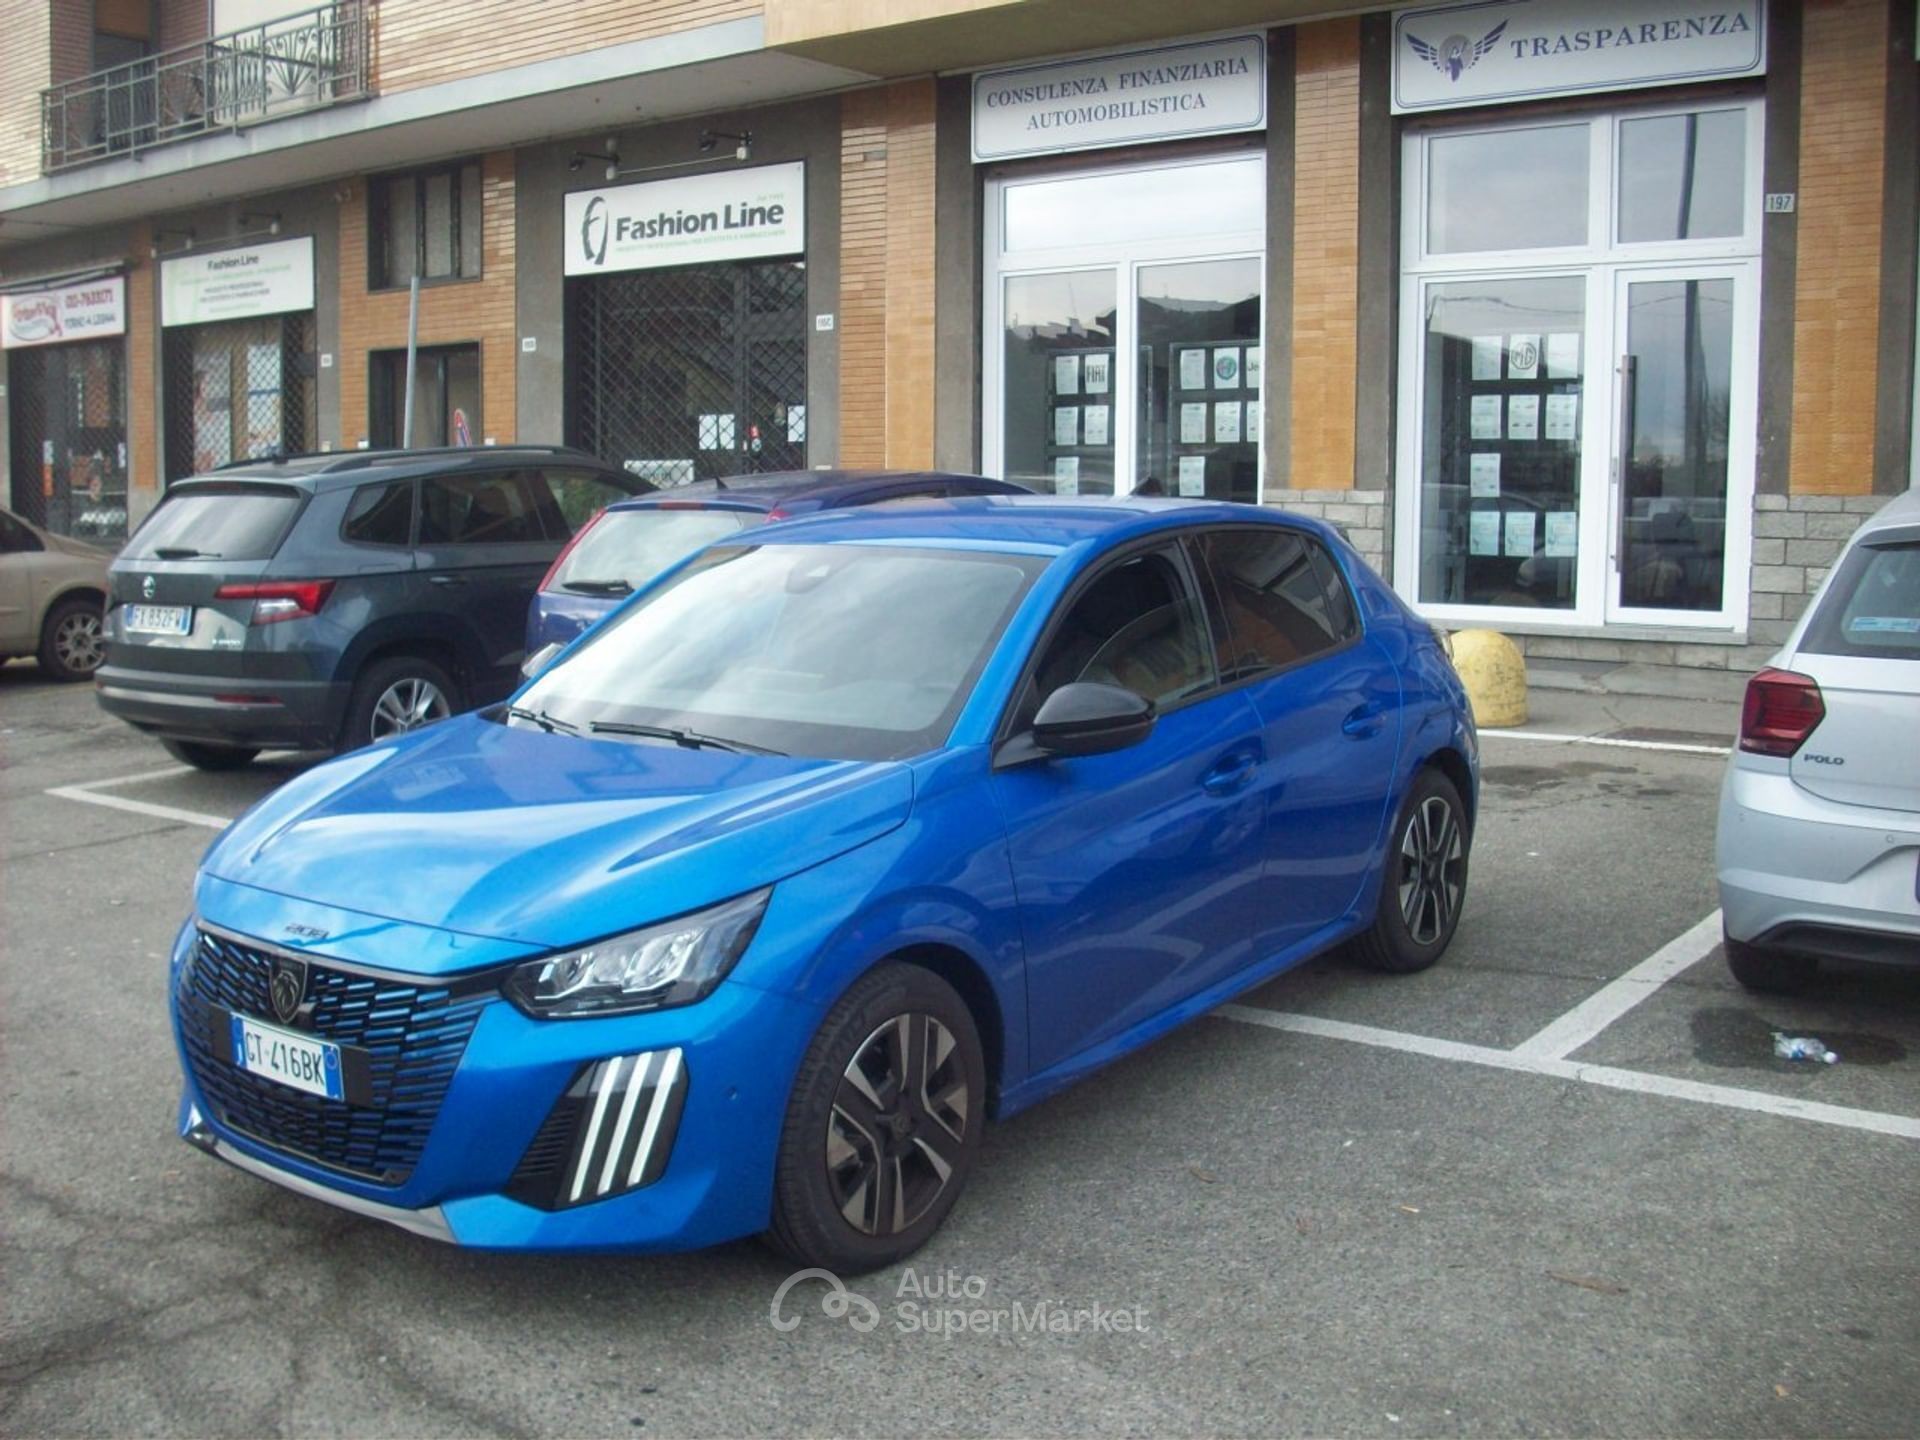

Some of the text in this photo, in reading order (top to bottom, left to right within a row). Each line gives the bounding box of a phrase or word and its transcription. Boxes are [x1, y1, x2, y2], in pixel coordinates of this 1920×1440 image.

[1511, 12, 1752, 59] TRASPARENZA
[987, 57, 1249, 108] CONSULENZA FINANZIARIA
[1026, 93, 1206, 130] AUTOMOBILISTICA
[1767, 195, 1791, 210] 197
[616, 210, 718, 241] Fashion
[724, 202, 784, 229] Line
[207, 255, 259, 271] Fashion Line
[1804, 754, 1845, 766] POLO
